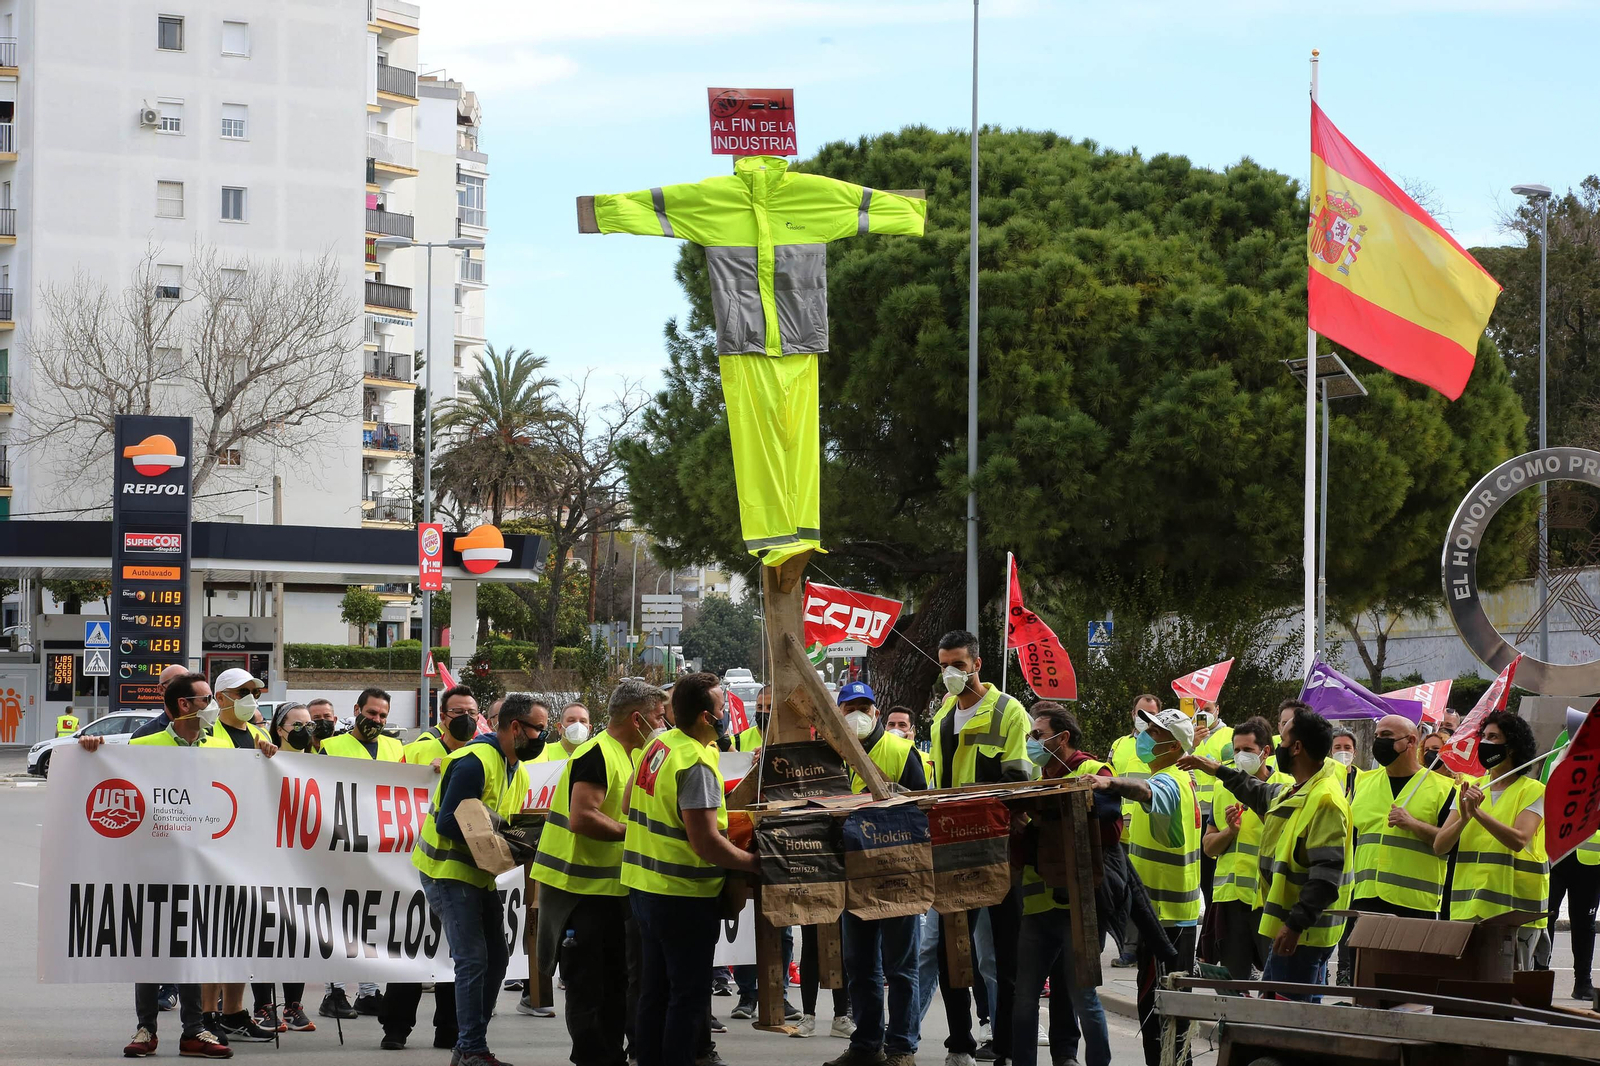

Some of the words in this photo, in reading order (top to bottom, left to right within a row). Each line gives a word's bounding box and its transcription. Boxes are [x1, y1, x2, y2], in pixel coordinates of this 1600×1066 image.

[713, 121, 728, 131] AL
[732, 118, 755, 131] FIN
[760, 121, 777, 132] DE
[780, 122, 795, 132] LA
[713, 136, 796, 150] INDUSTRIA
[1568, 456, 1600, 475] PR
[1496, 456, 1561, 492] COMO
[123, 483, 185, 495] REPSOL
[1452, 489, 1497, 567] HONOR
[132, 569, 173, 577] Autolavado
[1452, 573, 1471, 600] EL
[151, 591, 181, 603] 1.189
[150, 615, 181, 628] 1.269
[803, 594, 892, 639] CCOO
[150, 639, 180, 652] 1.269
[138, 664, 147, 672] 98
[785, 764, 825, 779] Holcim
[94, 788, 138, 812] UGT
[153, 788, 191, 805] FICA
[153, 807, 185, 815] Industria,
[276, 776, 322, 850] NO
[329, 781, 369, 853] AL
[153, 814, 197, 822] Construcción
[205, 815, 220, 824] Agro
[872, 829, 912, 845] Holcim
[950, 823, 990, 838] Holcim
[785, 838, 823, 850] Holcim
[68, 882, 333, 960] MANTENIMIENTO
[341, 888, 382, 959] DE
[387, 888, 442, 960] LOS
